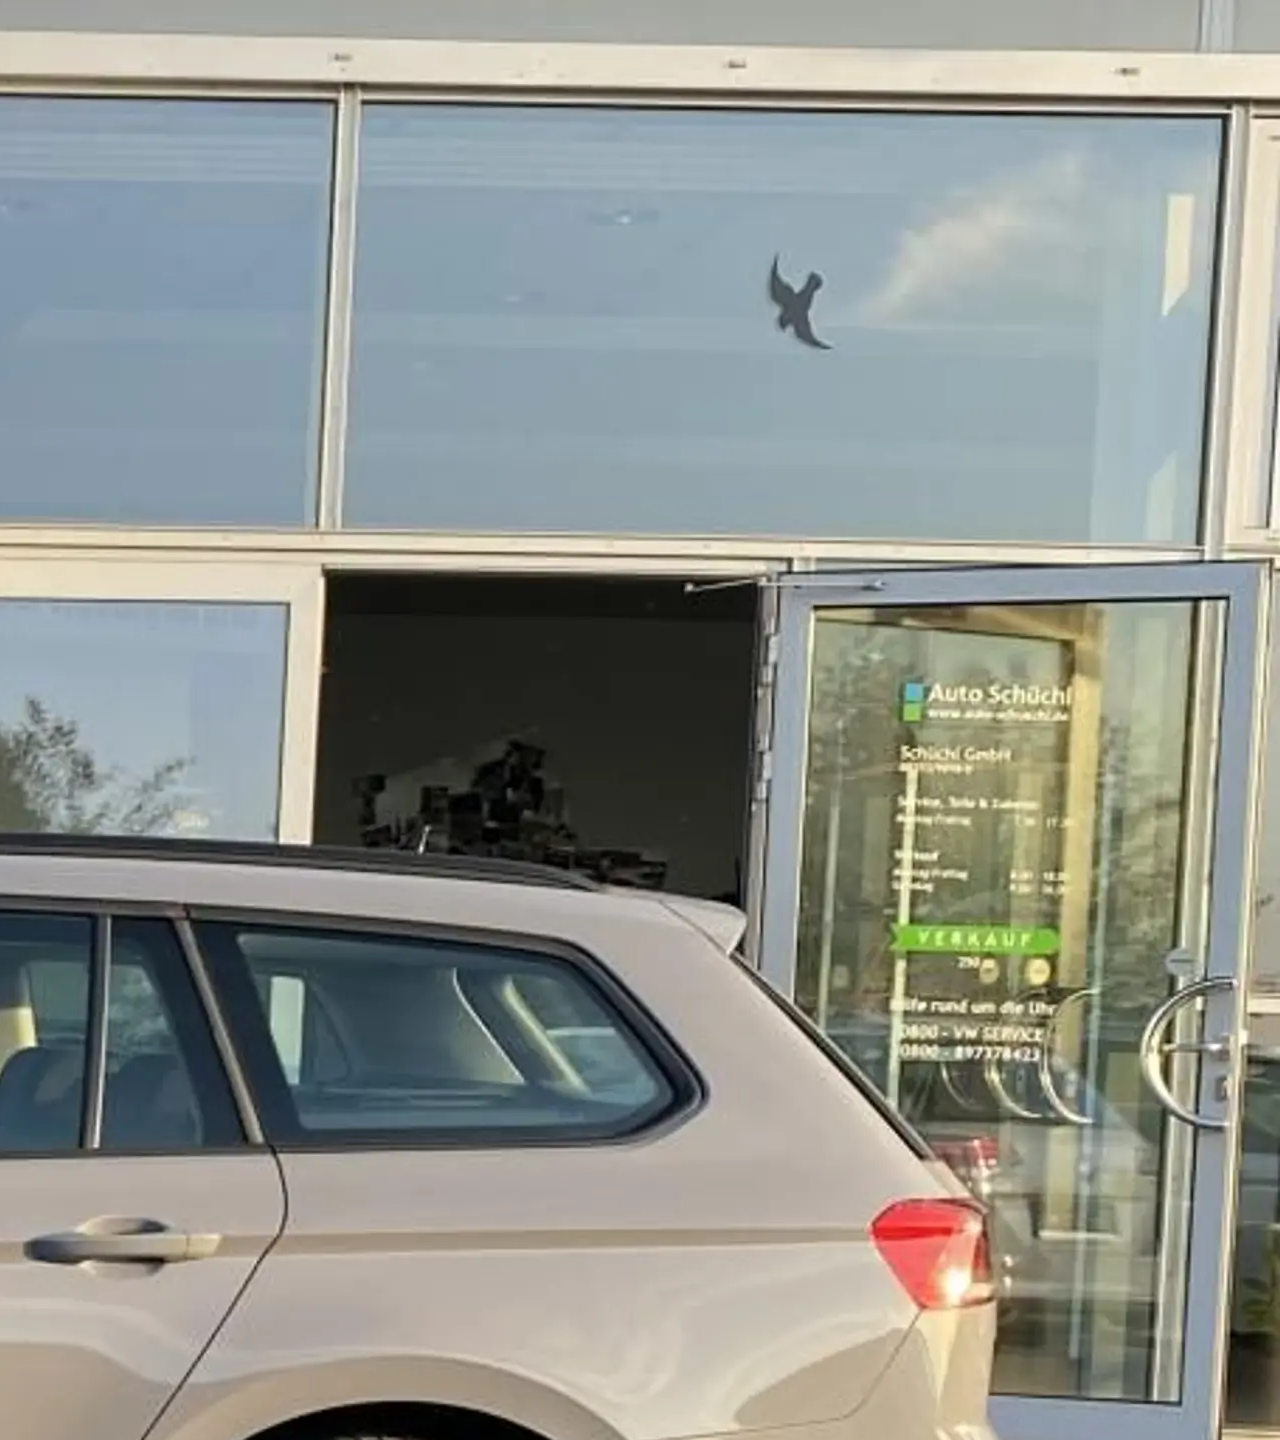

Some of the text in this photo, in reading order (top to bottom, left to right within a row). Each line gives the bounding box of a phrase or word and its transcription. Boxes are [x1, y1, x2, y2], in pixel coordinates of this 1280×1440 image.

[928, 682, 1072, 706] Auto Schüchl
[917, 930, 1033, 947] VERKAUF
[930, 999, 970, 1013] rund
[971, 1002, 997, 1014] um
[1029, 1001, 1059, 1016] Uhr
[953, 1025, 978, 1040] VW
[982, 1026, 1045, 1042] SERVICE
